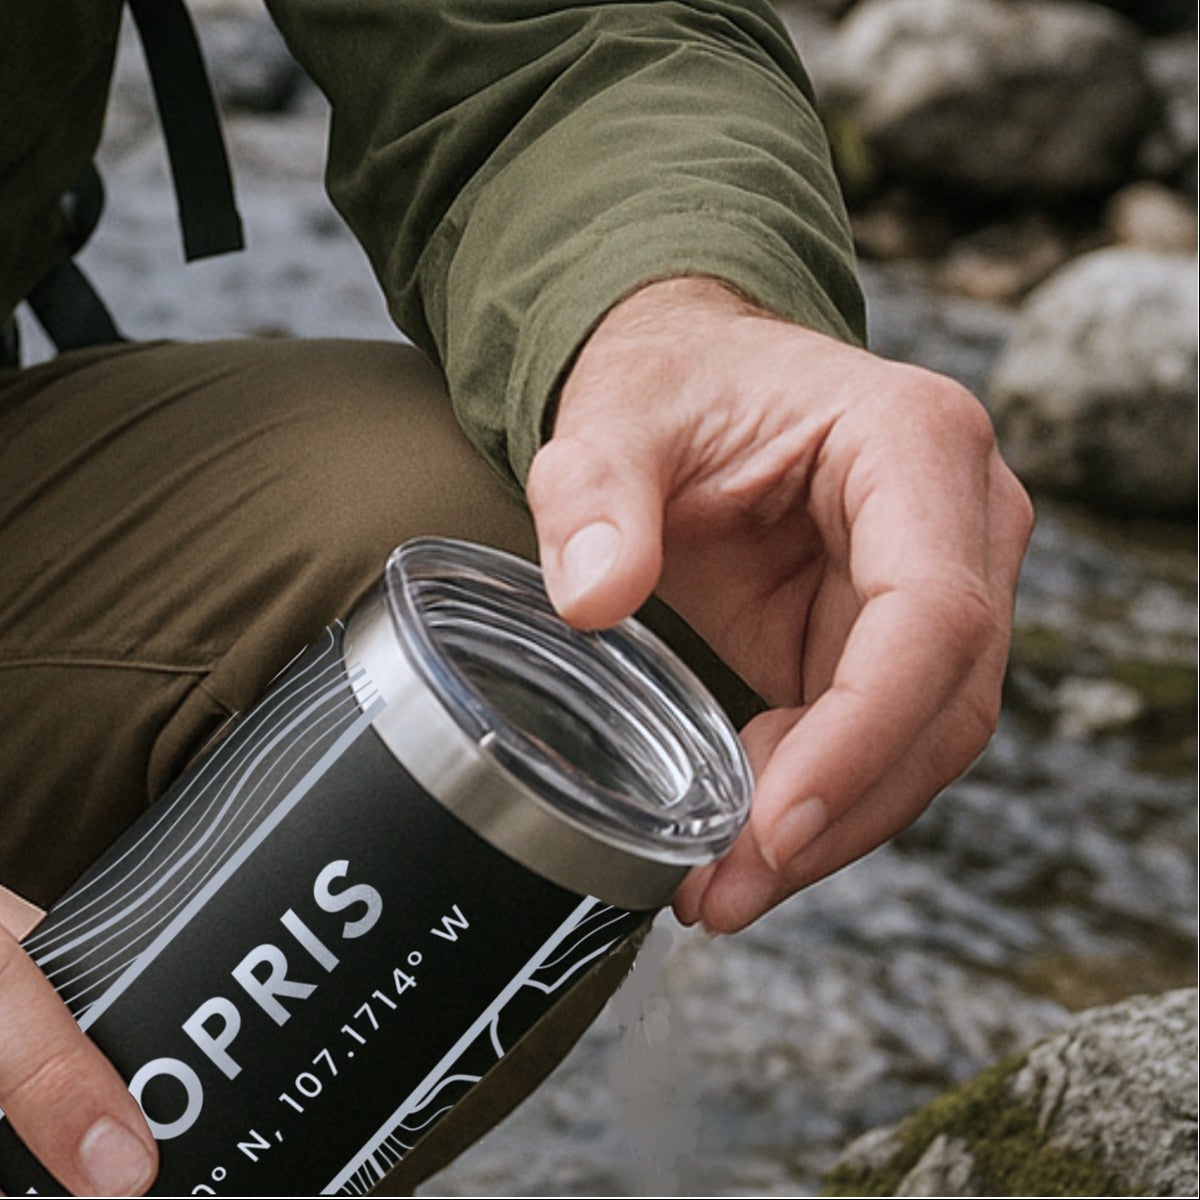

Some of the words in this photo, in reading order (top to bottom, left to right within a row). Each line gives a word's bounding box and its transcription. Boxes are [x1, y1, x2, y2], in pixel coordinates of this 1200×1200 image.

[128, 859, 383, 1140] OPRIS
[236, 1129, 284, 1163] N,
[278, 951, 423, 1113] 107.1714°
[430, 904, 470, 942] W
